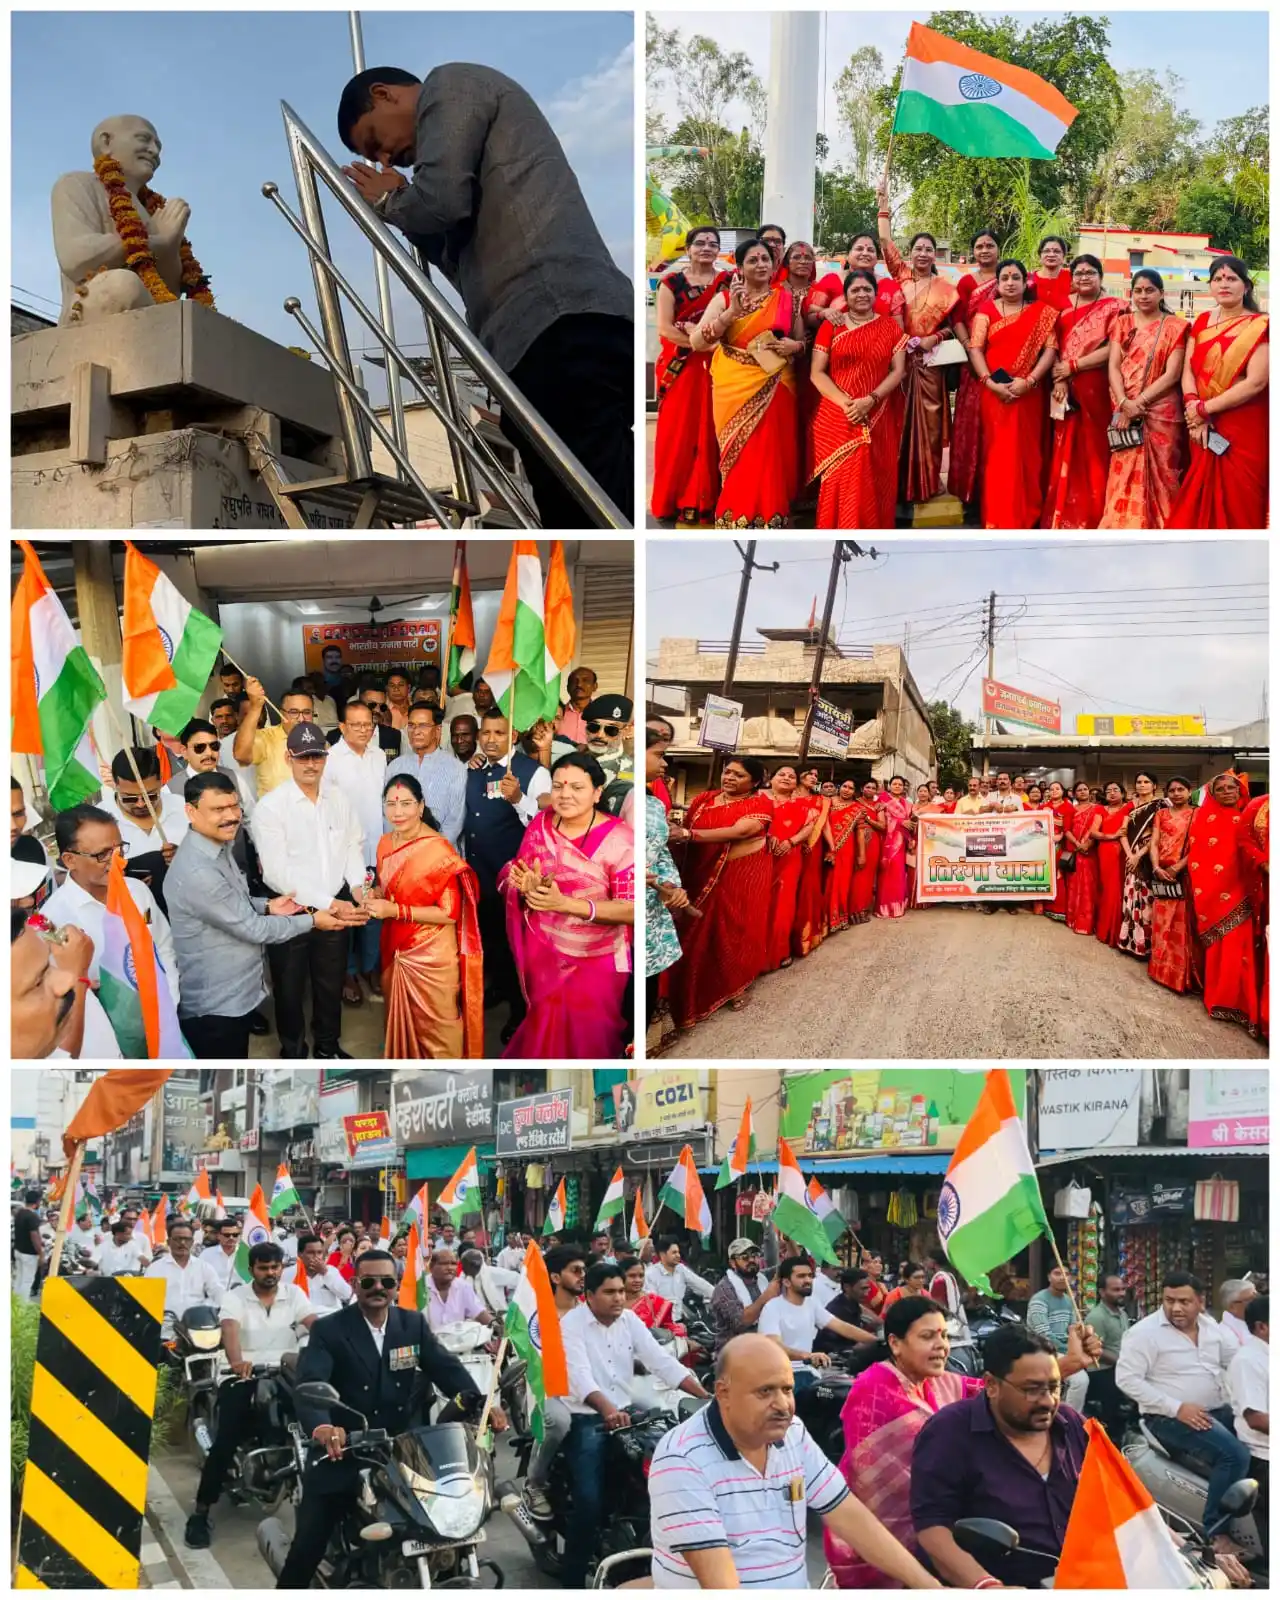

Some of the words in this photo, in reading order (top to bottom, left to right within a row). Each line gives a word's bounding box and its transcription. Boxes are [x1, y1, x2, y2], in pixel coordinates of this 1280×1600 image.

[222, 494, 252, 520] रघुपति
[349, 640, 379, 651] भारतीय
[380, 640, 402, 650] जनता
[929, 856, 992, 882] तिरंगा
[995, 859, 1046, 882] यात्रा
[655, 1083, 694, 1107] COZI
[1040, 1102, 1080, 1115] WASTIK
[1084, 1098, 1129, 1113] KIRANA
[396, 1076, 457, 1140] व्हेरायटी
[482, 1083, 488, 1099] &
[513, 1098, 535, 1136] दुर्गा
[1211, 1121, 1229, 1143] श्री
